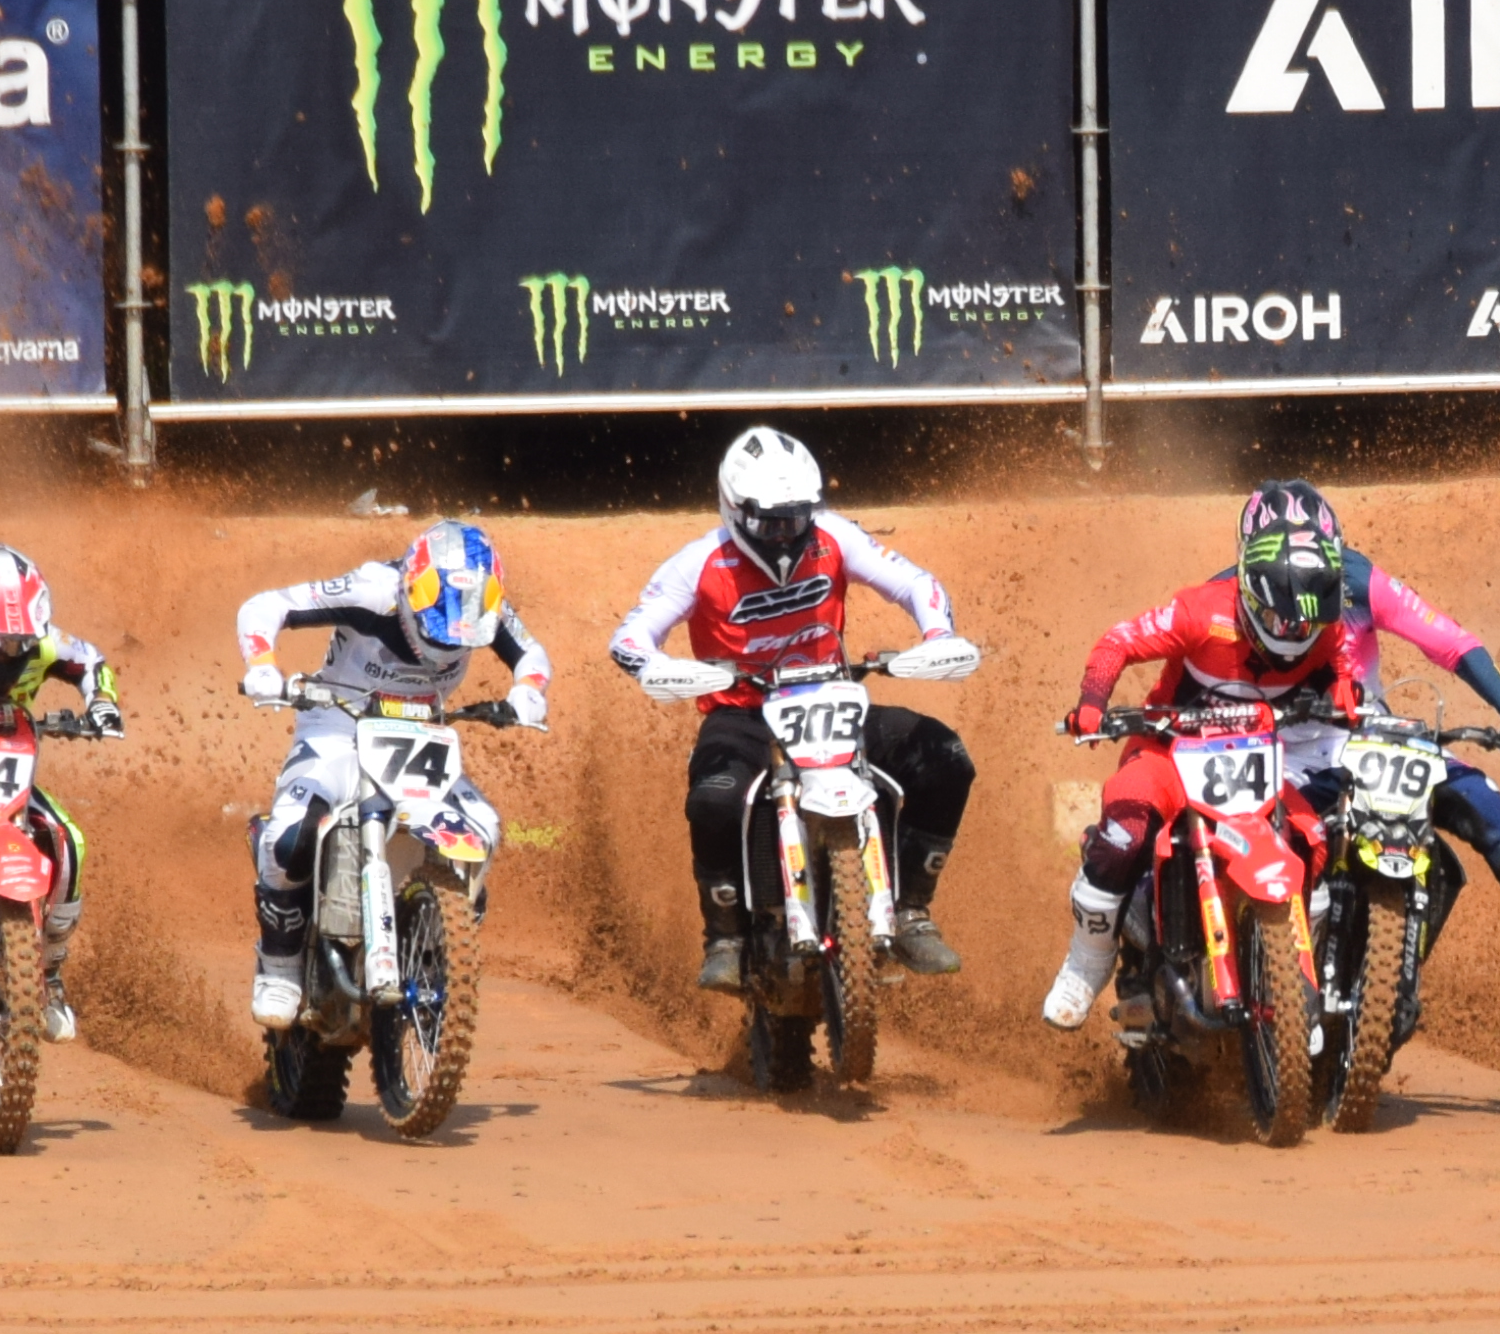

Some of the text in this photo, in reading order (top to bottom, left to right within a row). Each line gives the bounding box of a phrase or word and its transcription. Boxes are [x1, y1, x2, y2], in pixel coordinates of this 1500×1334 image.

[588, 40, 866, 73] ENERGY
[257, 294, 396, 323] MONSTER
[592, 286, 731, 317] MONSTER
[927, 280, 1065, 310] MONSTER
[1140, 293, 1341, 345] AIROH
[778, 700, 864, 748] 303
[371, 735, 452, 789] 74
[1201, 751, 1270, 807] 84
[1359, 750, 1432, 799] 919
